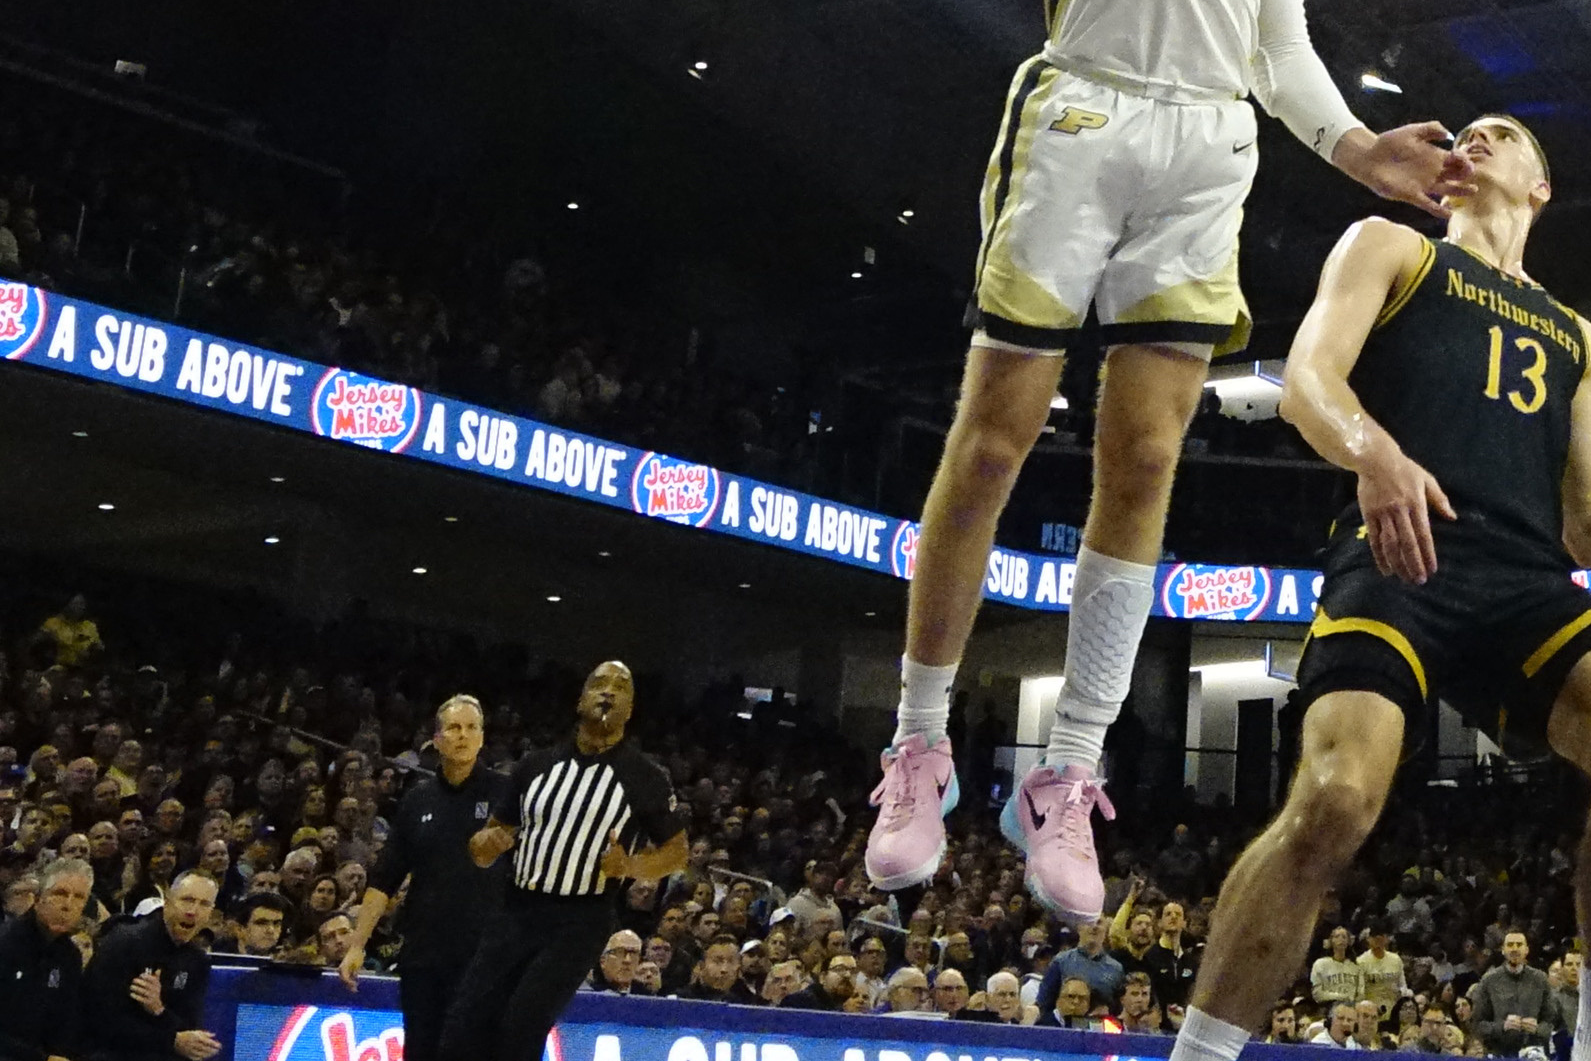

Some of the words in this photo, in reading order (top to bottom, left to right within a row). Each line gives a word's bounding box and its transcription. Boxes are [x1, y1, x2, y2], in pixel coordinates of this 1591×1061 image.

[1446, 268, 1580, 365] Northwestern
[47, 305, 76, 362] A
[90, 314, 167, 383] SUB
[176, 338, 293, 417] ABOVE
[1483, 325, 1547, 414] 13
[328, 376, 406, 412] Jersey
[423, 403, 444, 453] A
[457, 410, 517, 470] SUB
[525, 430, 618, 497] ABOVE
[644, 459, 708, 490] Jersey
[721, 481, 740, 527] A
[749, 486, 797, 541] SUB
[805, 503, 881, 563] ABOVE
[987, 551, 1029, 599] SUB
[1177, 567, 1255, 596] Jersey
[1277, 575, 1298, 615] A
